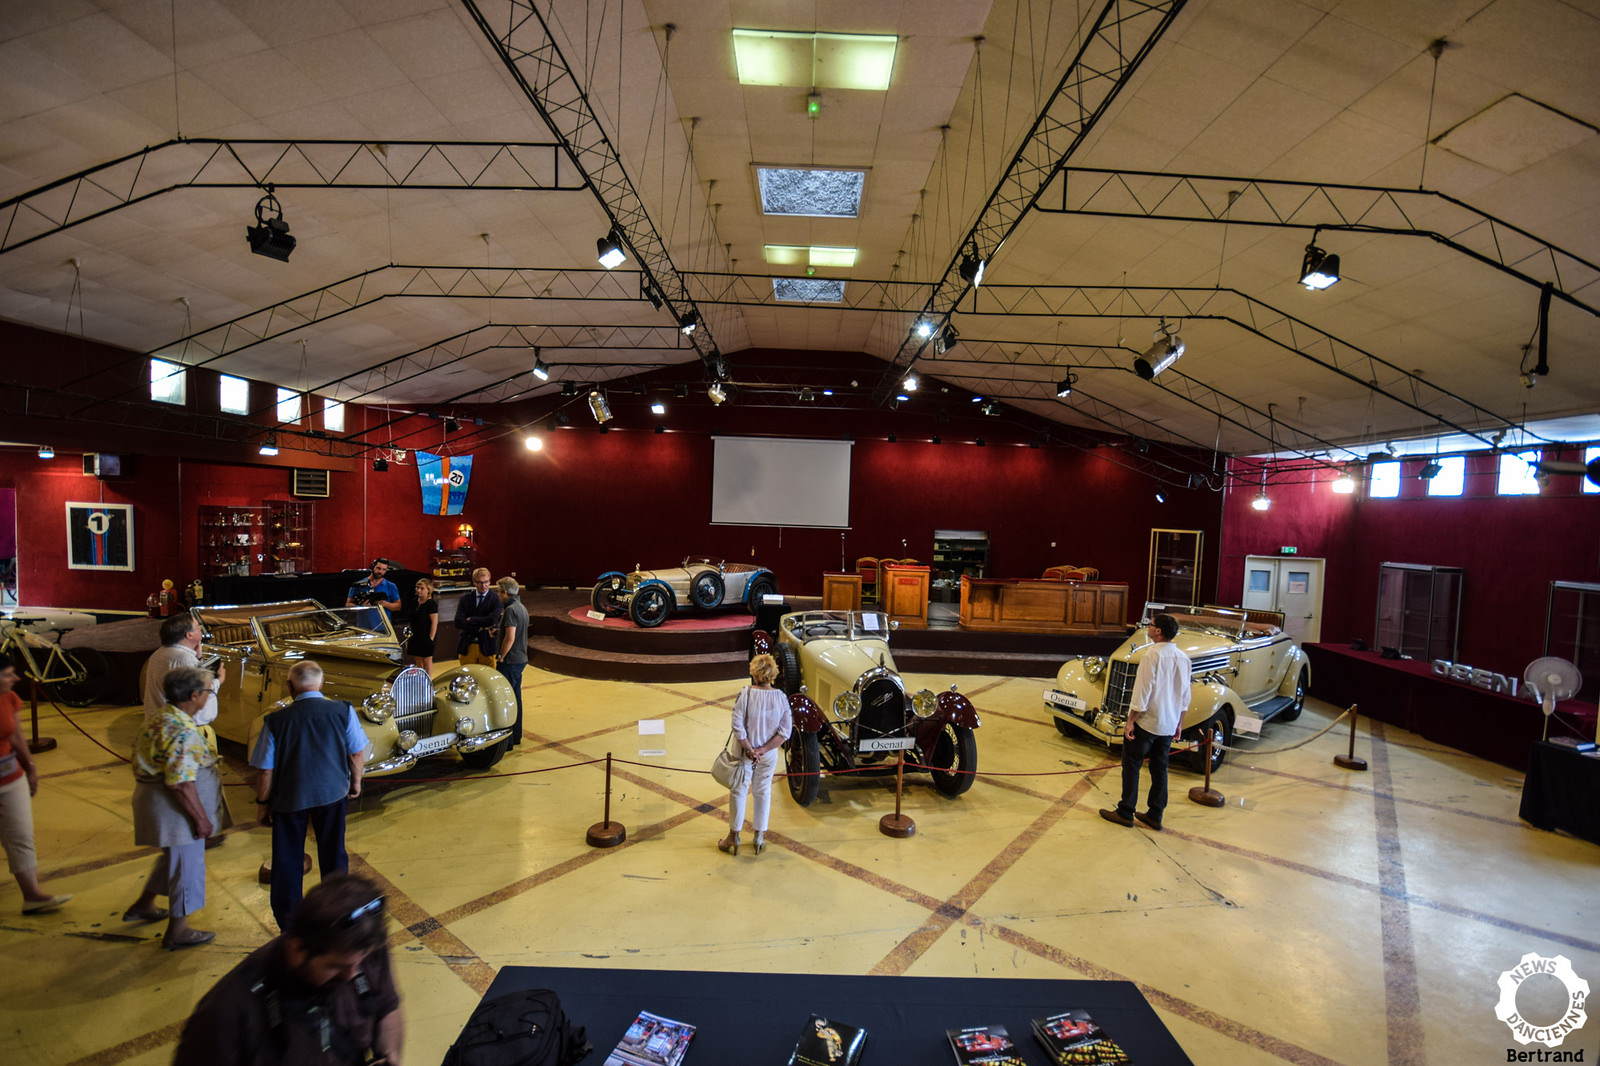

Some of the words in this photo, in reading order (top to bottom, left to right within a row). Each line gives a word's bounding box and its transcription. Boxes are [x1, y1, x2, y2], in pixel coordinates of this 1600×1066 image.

[91, 516, 103, 532] 1
[1050, 693, 1078, 707] Osenat
[413, 737, 450, 752] Osenat
[871, 740, 904, 750] Osenat
